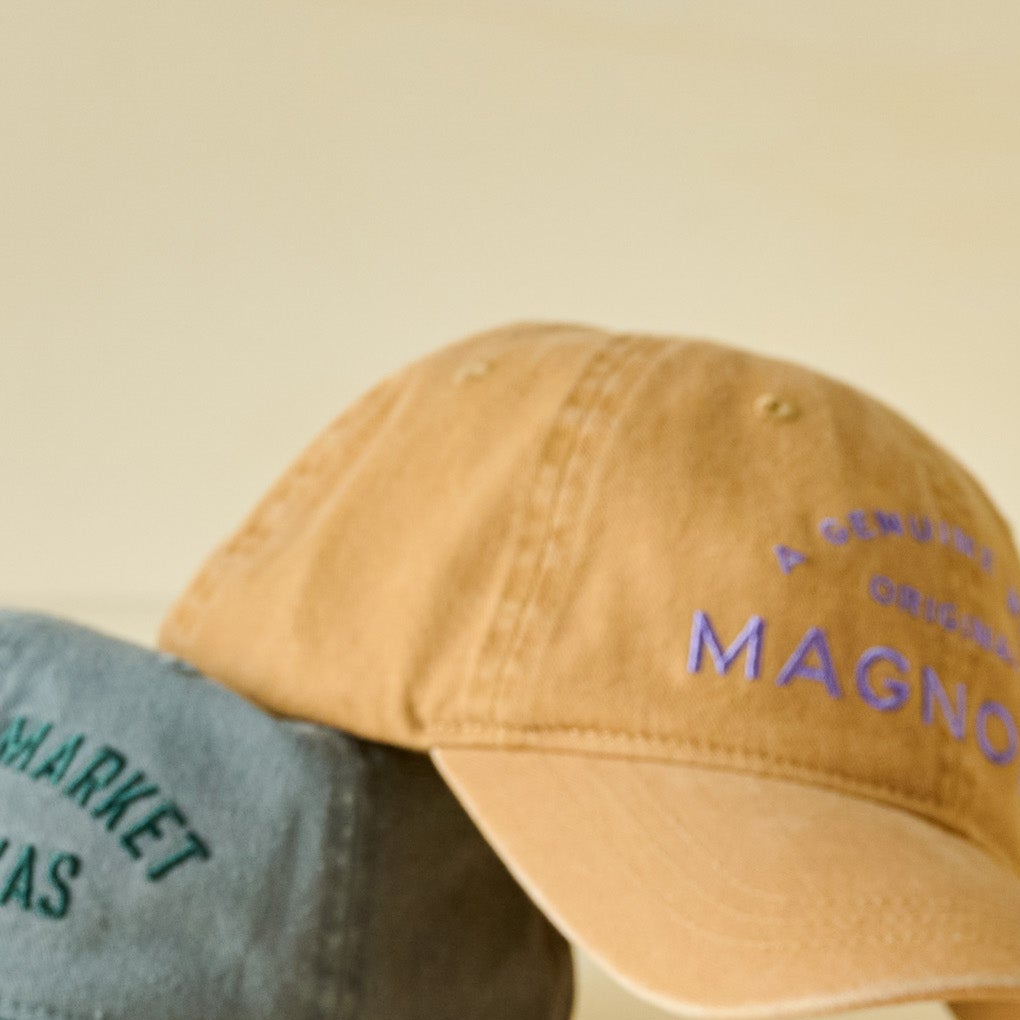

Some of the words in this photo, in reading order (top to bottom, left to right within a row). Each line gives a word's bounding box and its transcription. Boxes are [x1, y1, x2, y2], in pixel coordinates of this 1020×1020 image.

[772, 543, 807, 575] A
[0, 715, 211, 882] MARKET
[0, 838, 81, 919] AS
